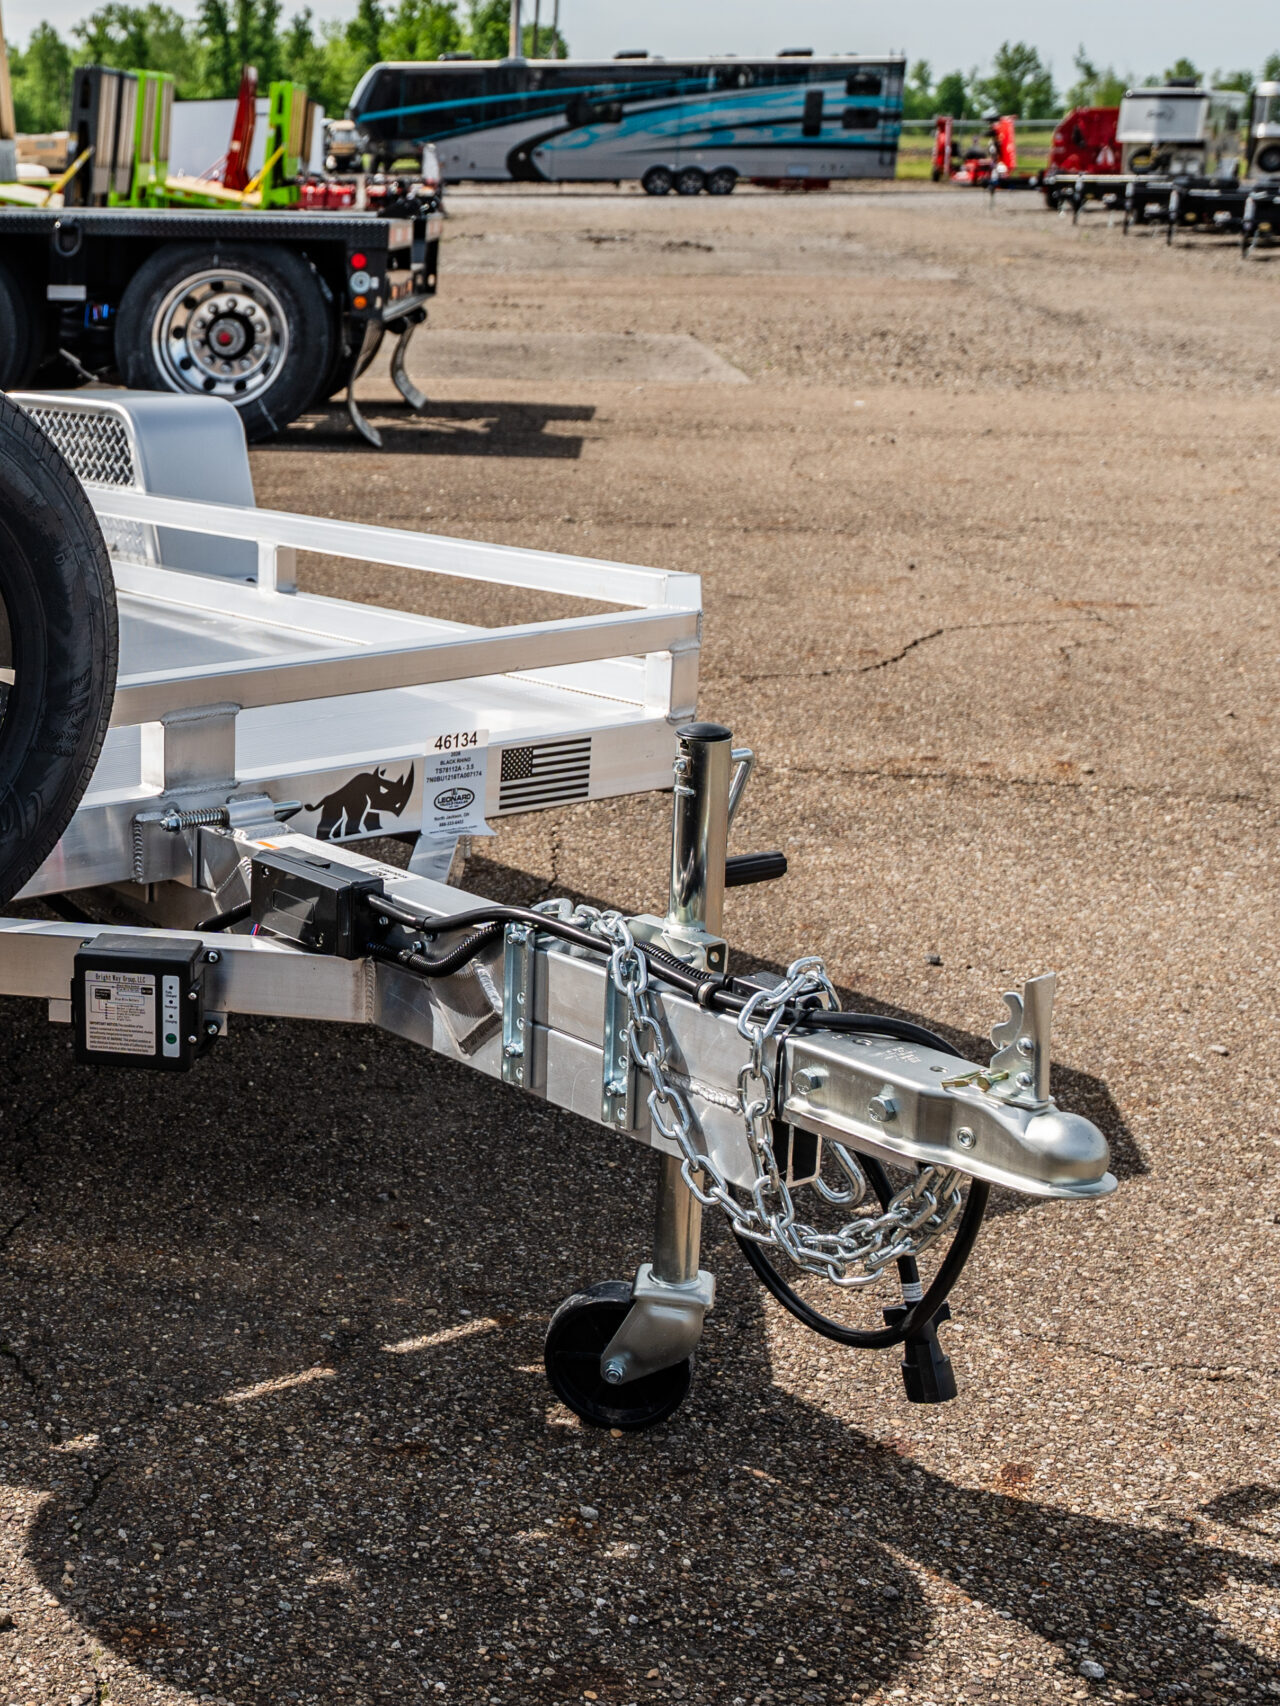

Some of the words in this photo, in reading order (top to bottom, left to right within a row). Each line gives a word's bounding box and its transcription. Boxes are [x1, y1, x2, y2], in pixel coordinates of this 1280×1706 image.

[434, 731, 477, 750] 46134
[438, 794, 471, 804] LEONARD
[95, 973, 111, 982] Bright
[112, 974, 121, 982] Way
